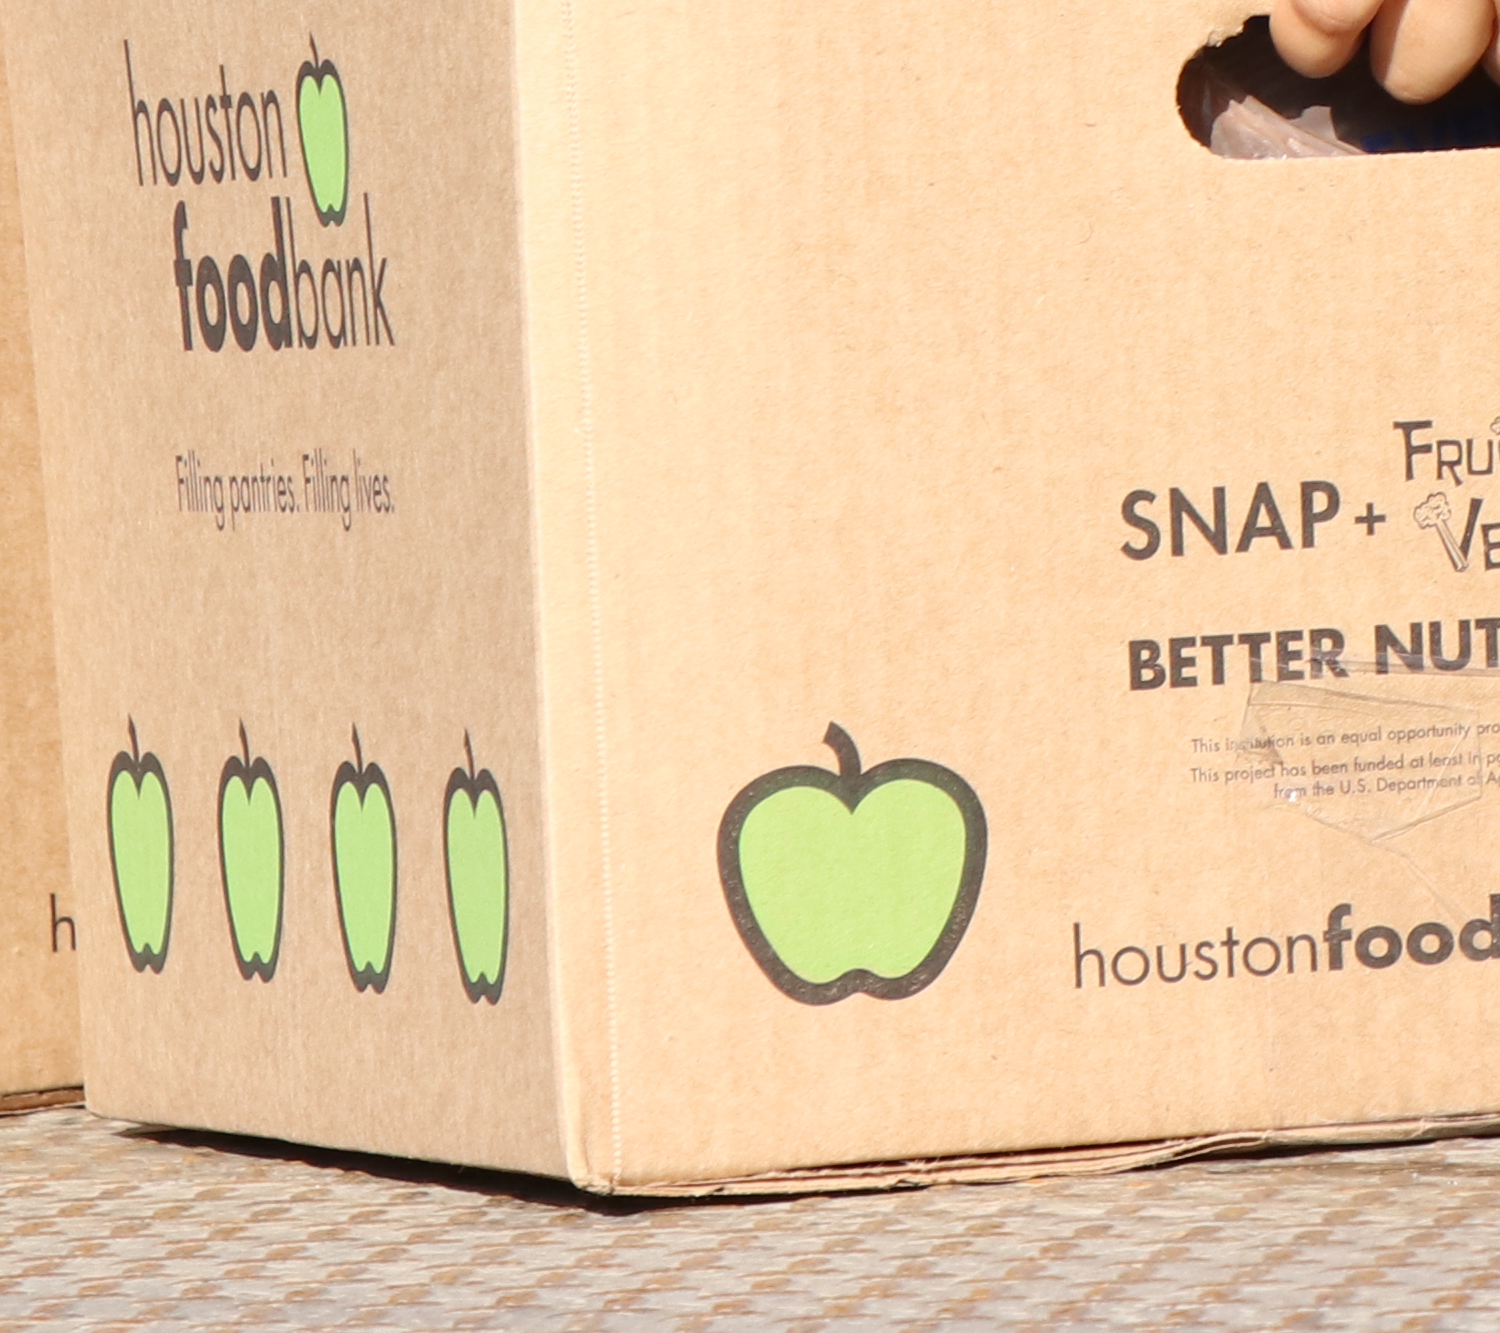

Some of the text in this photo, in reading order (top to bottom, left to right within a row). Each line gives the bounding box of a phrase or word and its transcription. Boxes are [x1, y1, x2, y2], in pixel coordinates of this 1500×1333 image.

[122, 38, 288, 187] houston
[173, 192, 395, 353] foodbank
[174, 447, 395, 533] Filling pantries. Filling lives.
[1121, 480, 1341, 561] SNAP
[1128, 628, 1350, 691] BETTER
[1190, 766, 1220, 783] This
[1224, 761, 1276, 786] project
[1280, 759, 1307, 778] has
[1312, 759, 1348, 776] been
[1353, 753, 1405, 773] funded
[1409, 755, 1425, 771] at
[1191, 737, 1220, 753] This
[1300, 731, 1312, 746] is
[1315, 733, 1336, 746] an
[1341, 725, 1382, 746] equal
[1387, 722, 1472, 745] opportunity
[1311, 779, 1336, 797] the
[1339, 778, 1372, 795] U.S.
[1376, 772, 1463, 795] Department
